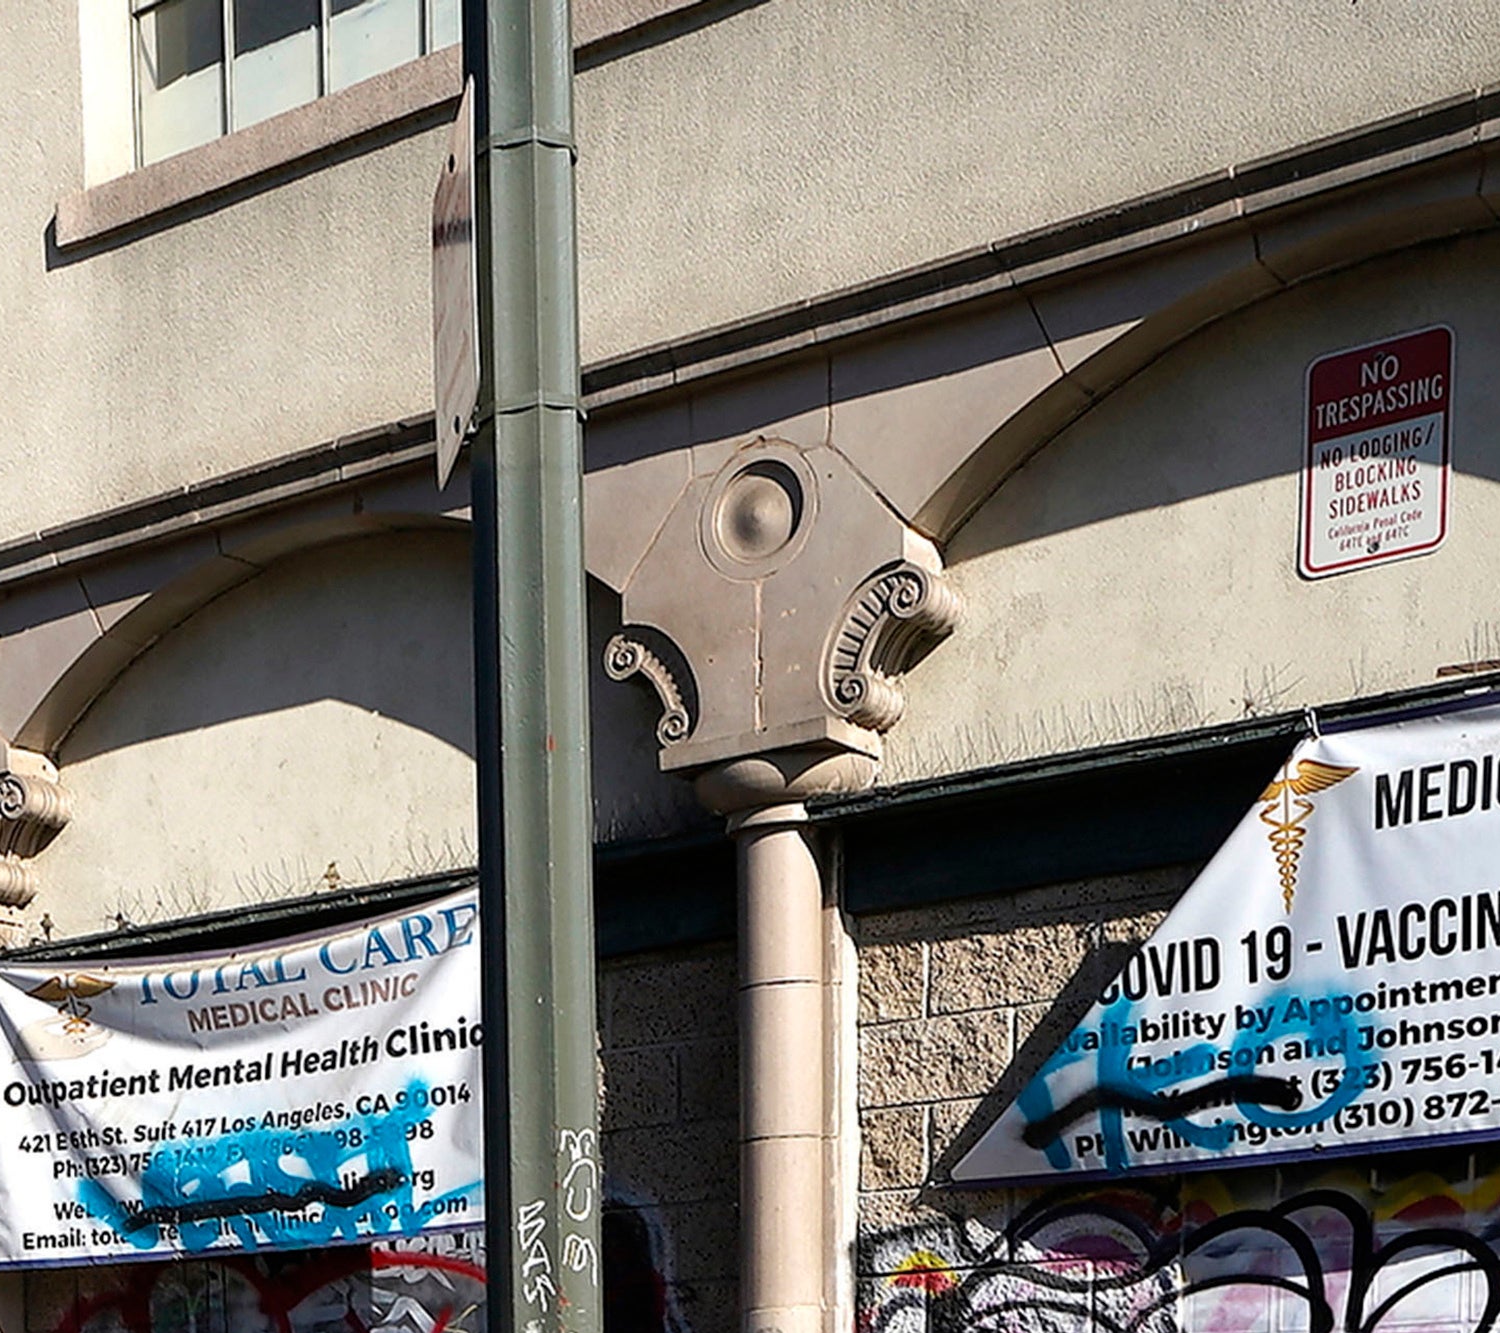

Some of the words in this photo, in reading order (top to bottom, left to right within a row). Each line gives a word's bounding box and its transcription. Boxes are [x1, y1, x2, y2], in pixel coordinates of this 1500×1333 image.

[1361, 355, 1399, 387] NO
[1316, 374, 1443, 430] TRESPASSING
[1320, 447, 1343, 470] NO
[1334, 455, 1417, 493] BLOCKING
[1329, 480, 1421, 520] SIDEWALKS
[319, 903, 477, 976] CARE
[1241, 925, 1292, 986] 19
[187, 992, 319, 1034] MEDICAL
[323, 972, 419, 1012] CLINIC
[1235, 1004, 1275, 1033] by
[1282, 1028, 1348, 1061] and
[3, 1068, 160, 1110] Outpatient
[167, 1052, 273, 1092] Mental
[281, 1034, 379, 1078] Health
[19, 1134, 51, 1154] 421
[56, 1132, 67, 1150] E
[71, 1128, 100, 1150] 6th
[102, 1126, 128, 1147] St.
[133, 1121, 177, 1143] Suit
[182, 1117, 217, 1138] 417
[220, 1115, 256, 1135] Los
[261, 1099, 351, 1131] Angeles,
[356, 1093, 390, 1115] CA
[396, 1082, 471, 1112] 90014
[1333, 1096, 1414, 1135] (310)
[53, 1160, 83, 1180] Ph:
[85, 1153, 128, 1180] (323)
[22, 1227, 87, 1251] Email:
